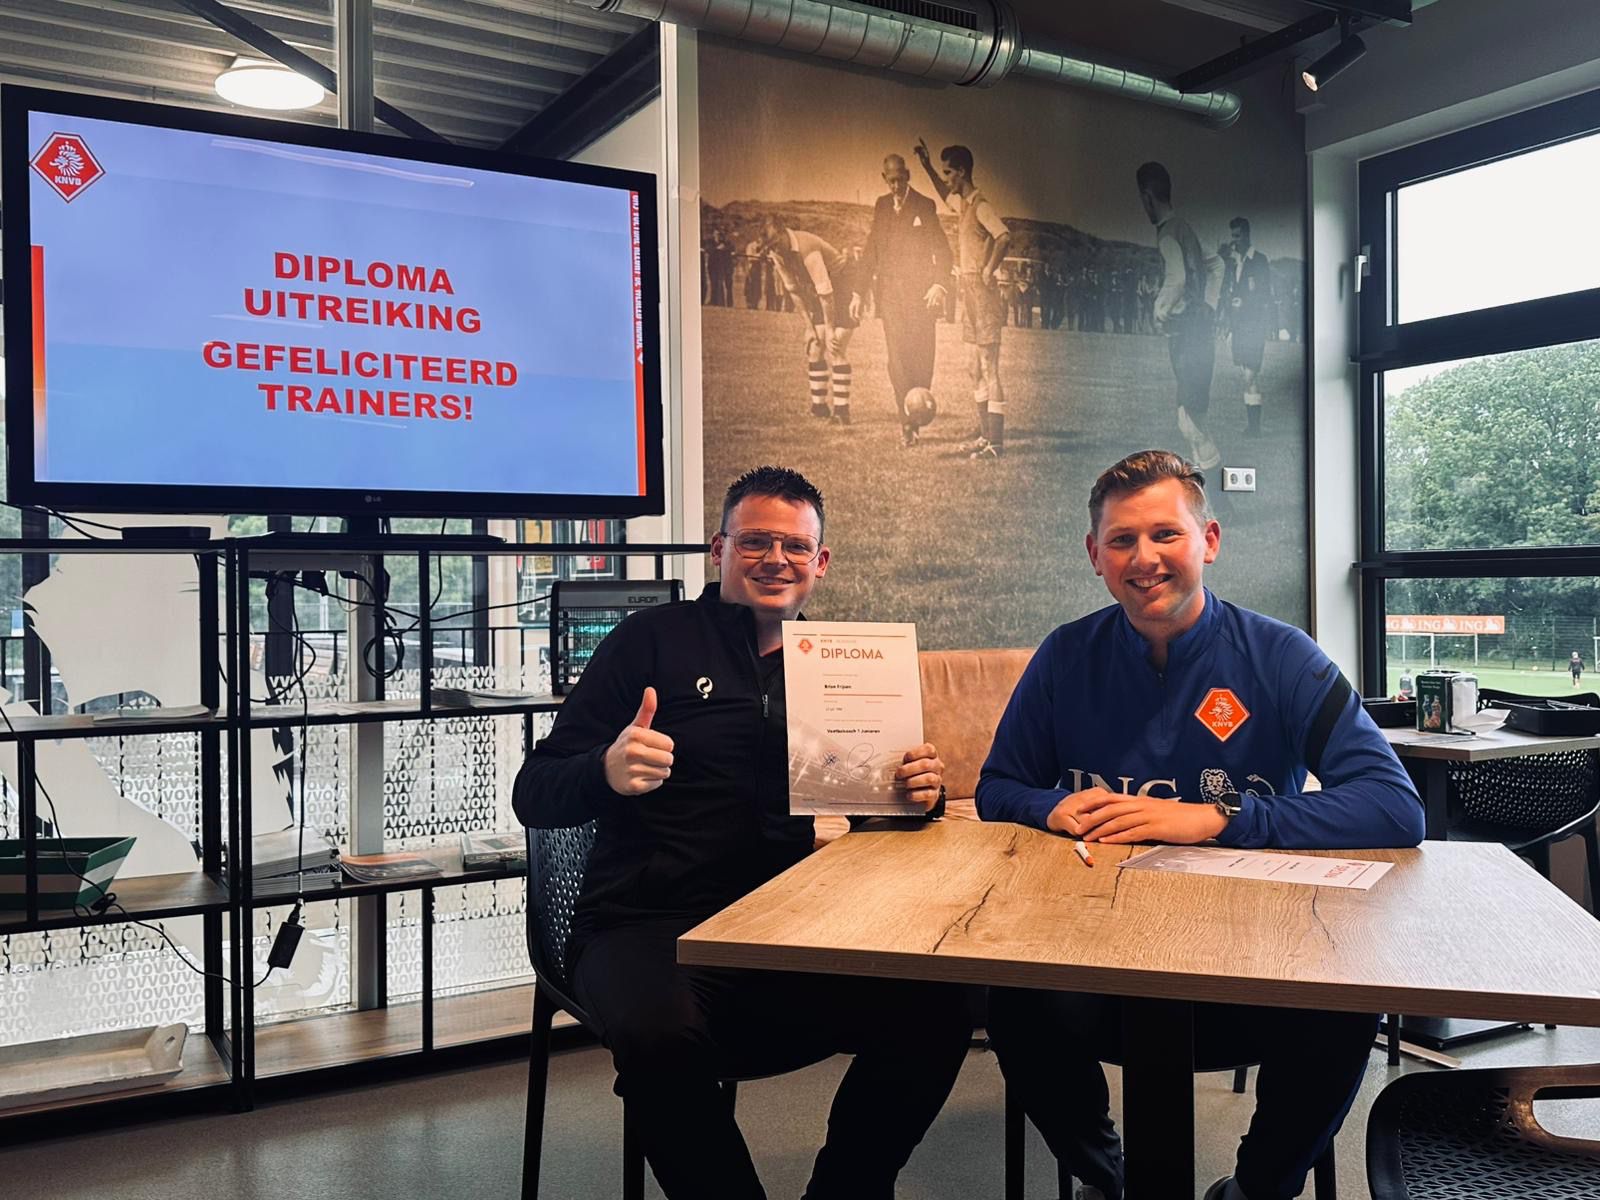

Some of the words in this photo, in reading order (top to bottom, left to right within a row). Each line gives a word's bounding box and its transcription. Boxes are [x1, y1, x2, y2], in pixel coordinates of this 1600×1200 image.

[54, 175, 82, 186] KNVB
[274, 251, 455, 295] DIPLOMA
[244, 287, 481, 334] UITREIKING
[202, 341, 518, 387] GEFELICITEERD
[257, 383, 473, 421] TRAINERS!
[1418, 619, 1440, 630] ING
[1459, 620, 1483, 631] ING
[821, 647, 884, 660] DIPLOMA
